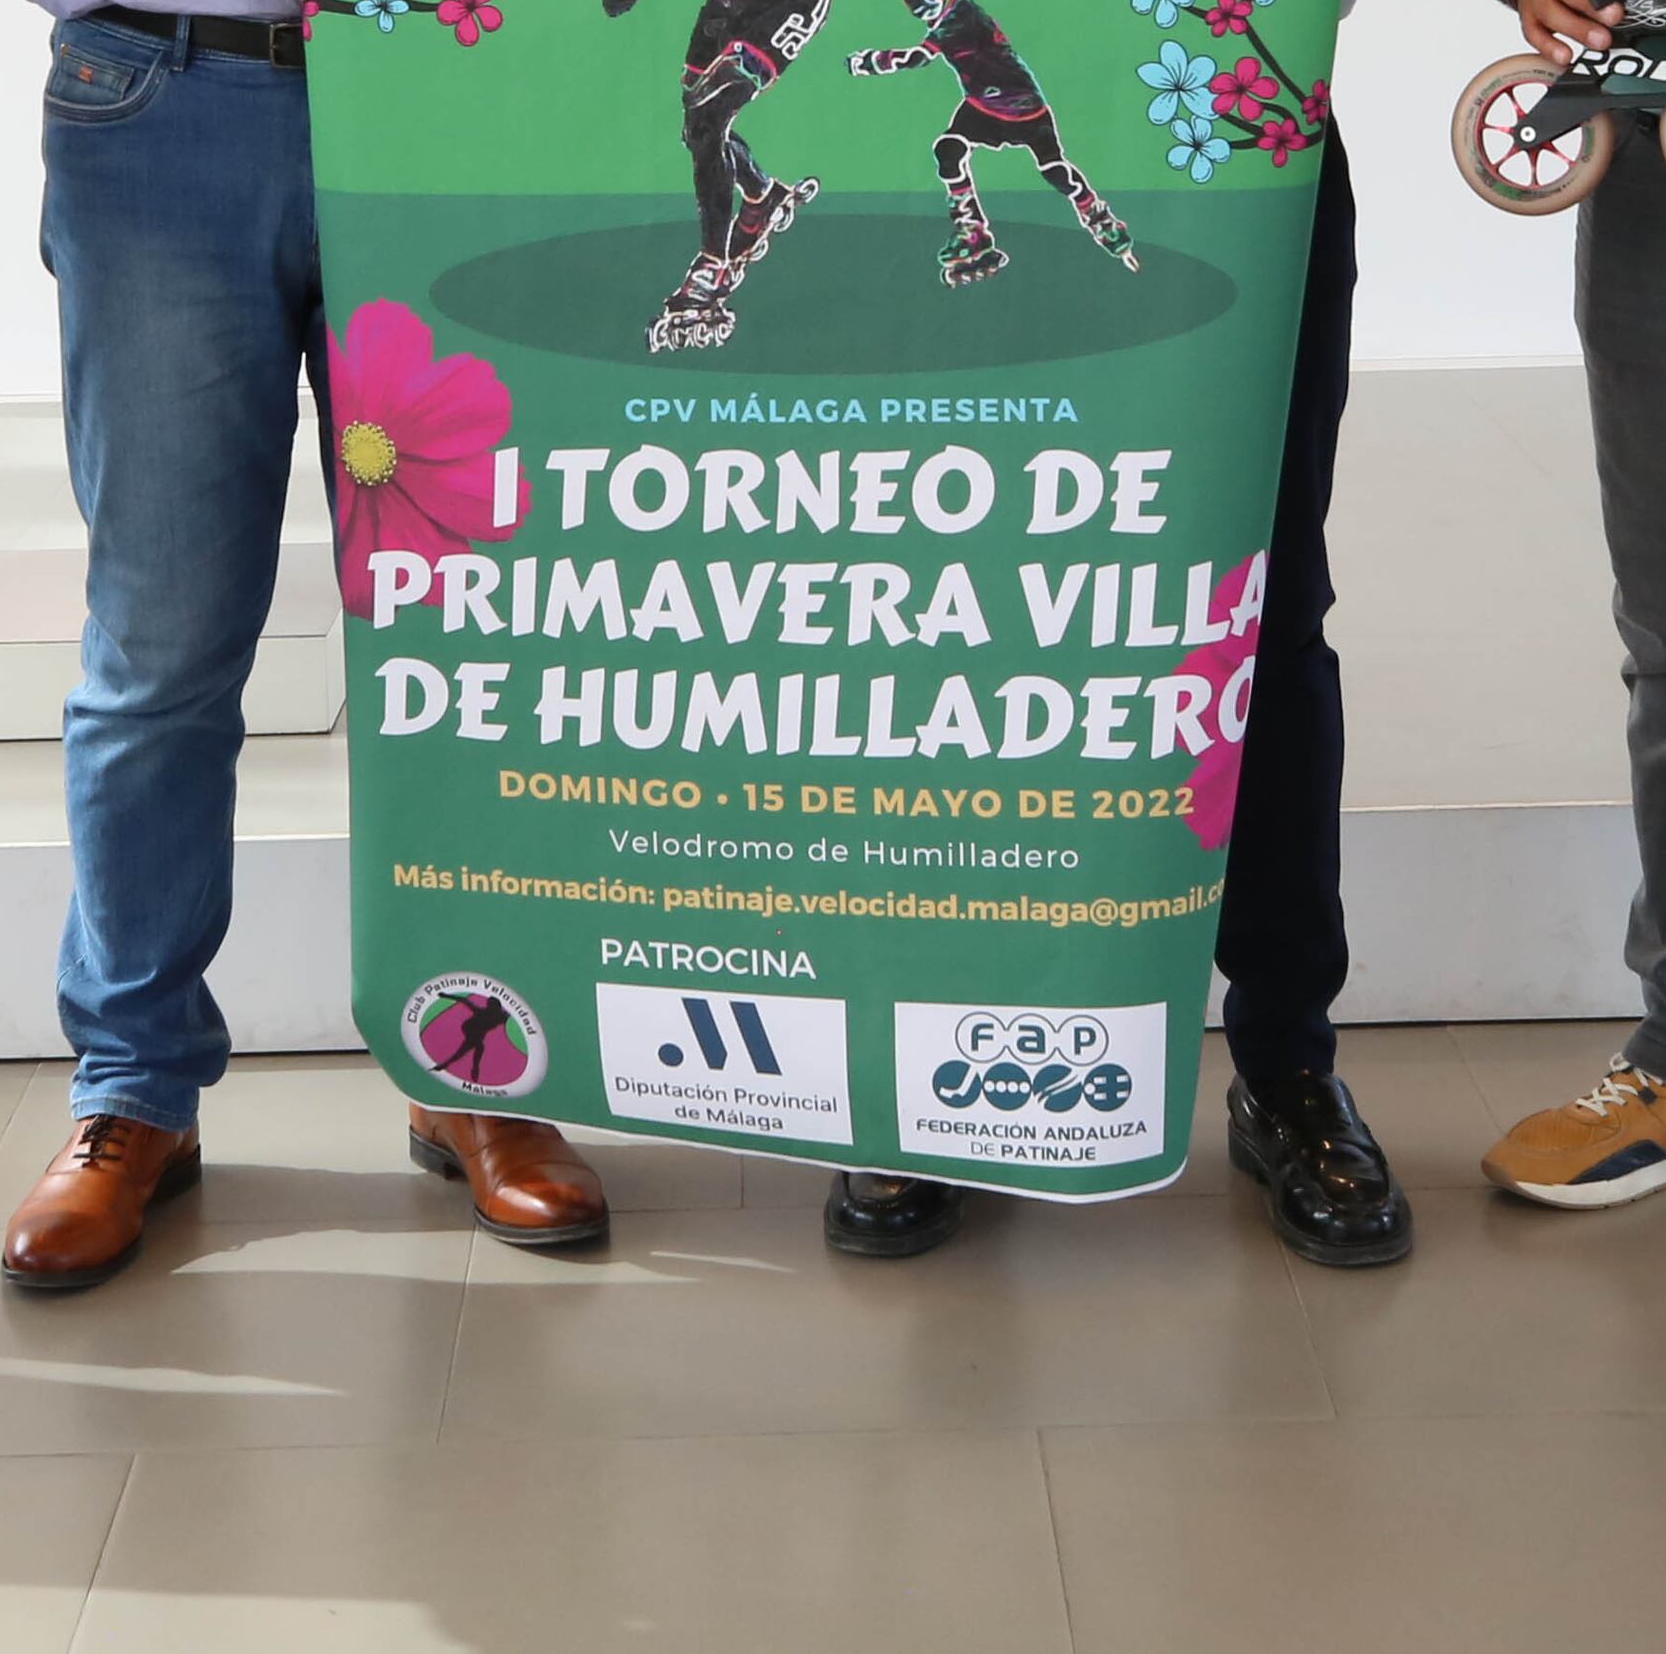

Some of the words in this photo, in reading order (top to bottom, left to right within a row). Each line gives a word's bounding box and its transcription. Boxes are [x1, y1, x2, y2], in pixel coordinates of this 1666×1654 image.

[624, 397, 702, 423] CPV
[710, 390, 868, 426] MÁLAGA
[880, 396, 1079, 423] PRESENTA
[492, 447, 520, 529] I
[545, 443, 996, 536] TORNEO
[1022, 448, 1172, 536] DE
[367, 549, 992, 648] PRIMAVERA
[1018, 549, 1267, 648] VILLA
[375, 657, 511, 742] DE
[534, 654, 1256, 759] HUMILLADERO
[498, 769, 703, 809] DOMINGO
[743, 781, 784, 812] 15
[802, 785, 857, 816] DE
[873, 786, 1002, 819] MAYO
[1019, 788, 1076, 819] DE
[1092, 786, 1195, 819] 2022
[608, 829, 795, 863] Velodromo
[807, 835, 849, 865] de
[863, 839, 1080, 870] Humilladero
[393, 863, 453, 893] Más
[461, 865, 655, 907] información:
[600, 937, 817, 981] PATROCINA
[407, 995, 426, 1023] Club
[615, 1076, 728, 1104] Diputación
[734, 1087, 838, 1113] Provincial
[674, 1104, 701, 1120] de
[707, 1106, 784, 1131] Málaga
[916, 1117, 1037, 1139] FEDERACIÓN
[1044, 1121, 1148, 1141] ANDALUZA
[970, 1141, 995, 1156] DE
[1001, 1144, 1096, 1161] PATINAJE
